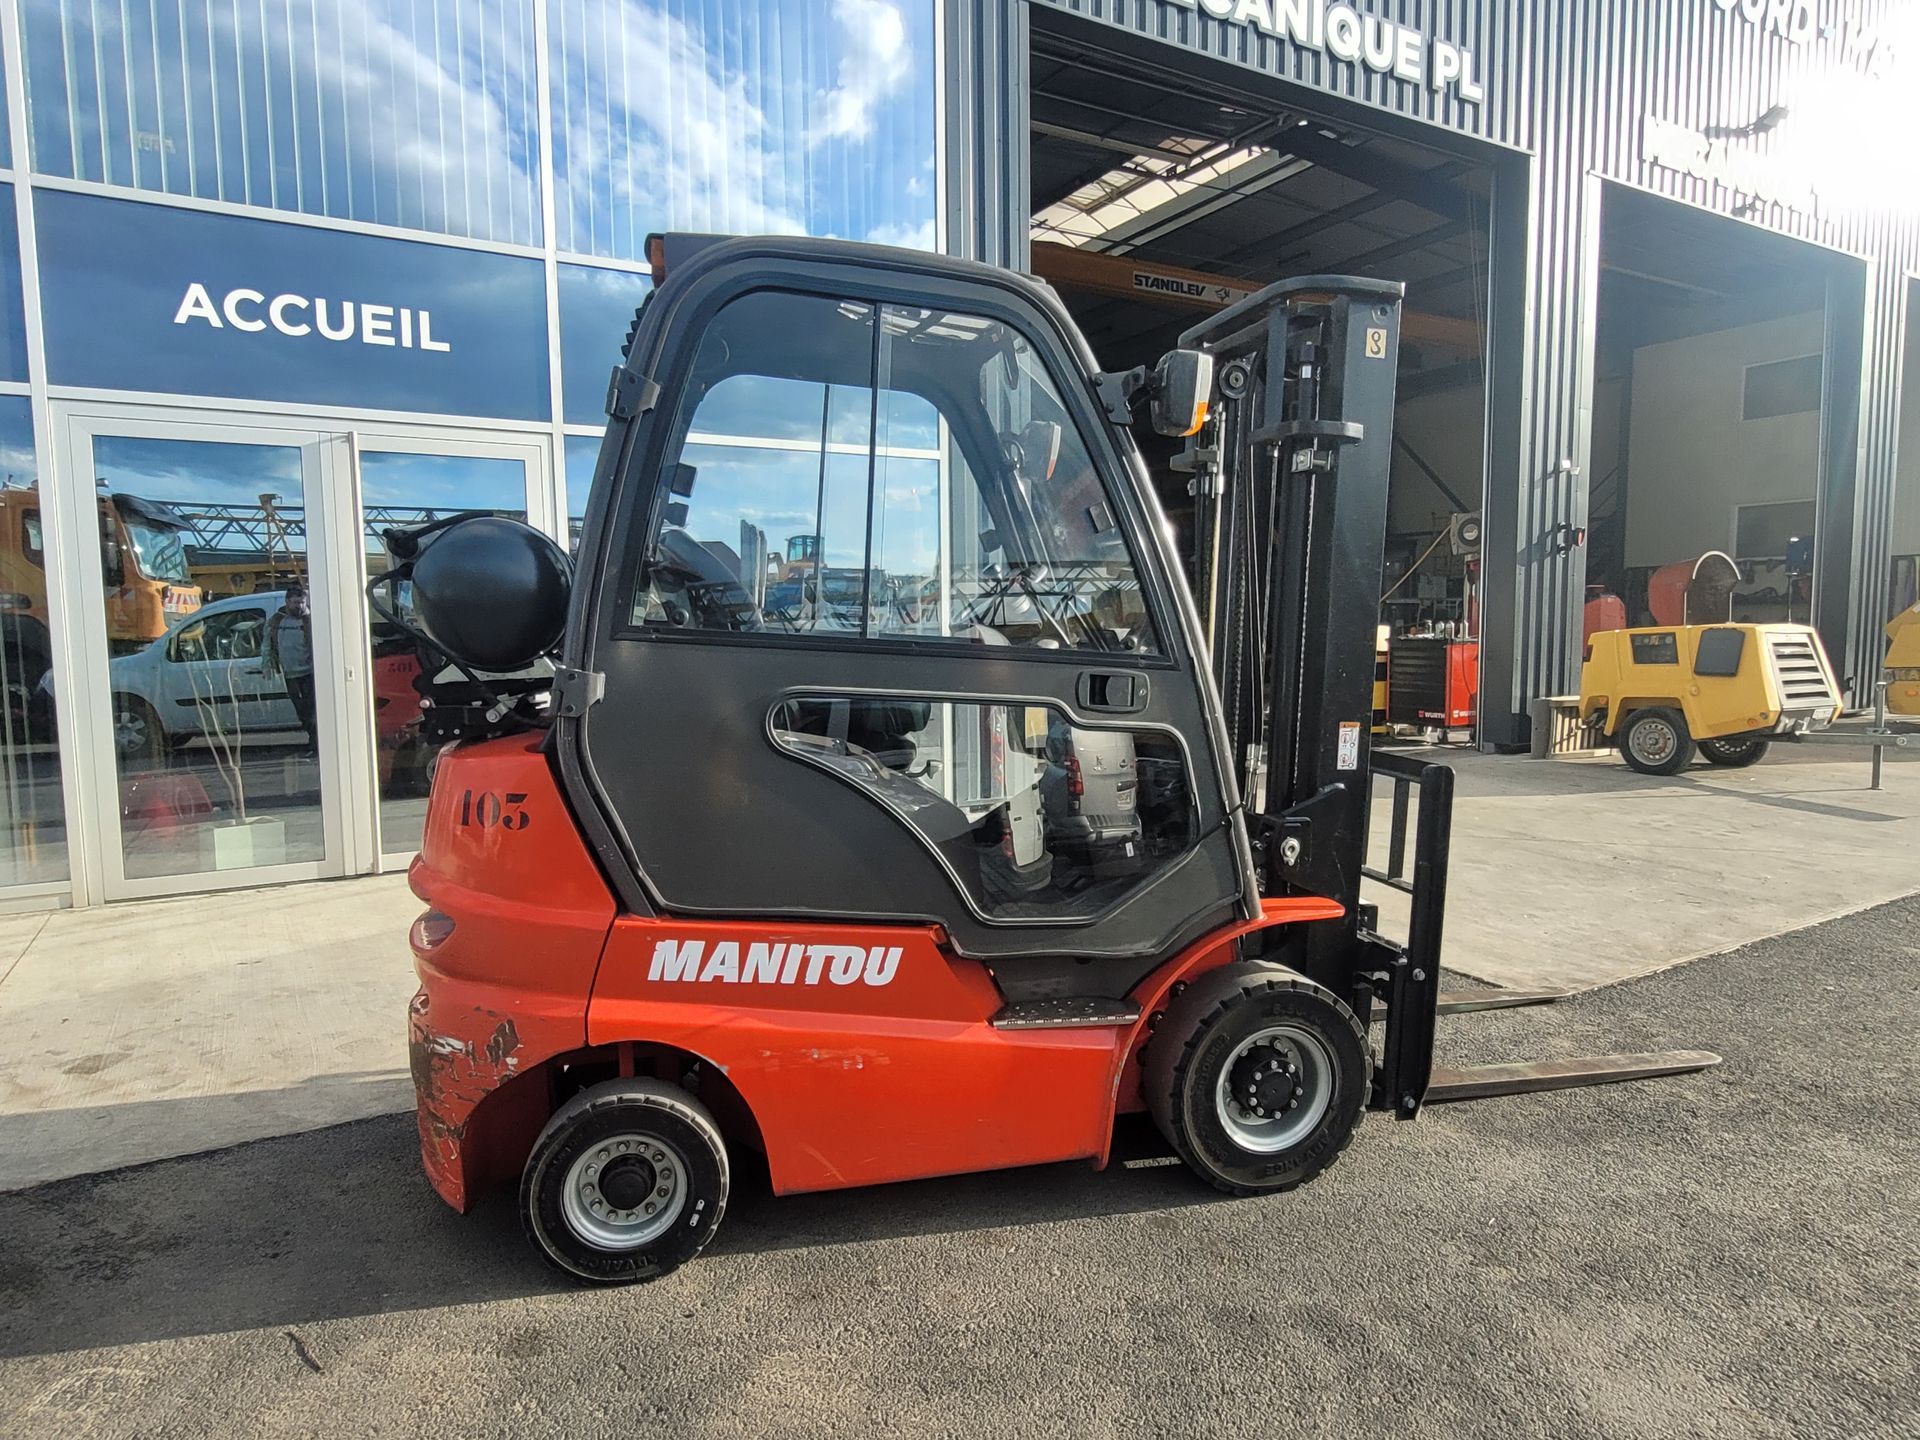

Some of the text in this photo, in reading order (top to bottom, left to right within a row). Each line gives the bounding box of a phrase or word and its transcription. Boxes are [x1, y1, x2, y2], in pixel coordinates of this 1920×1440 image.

[1434, 41, 1483, 99] PL
[174, 282, 450, 352] ACCUEIL
[461, 789, 530, 831] 103
[647, 939, 904, 986] MANITOU
